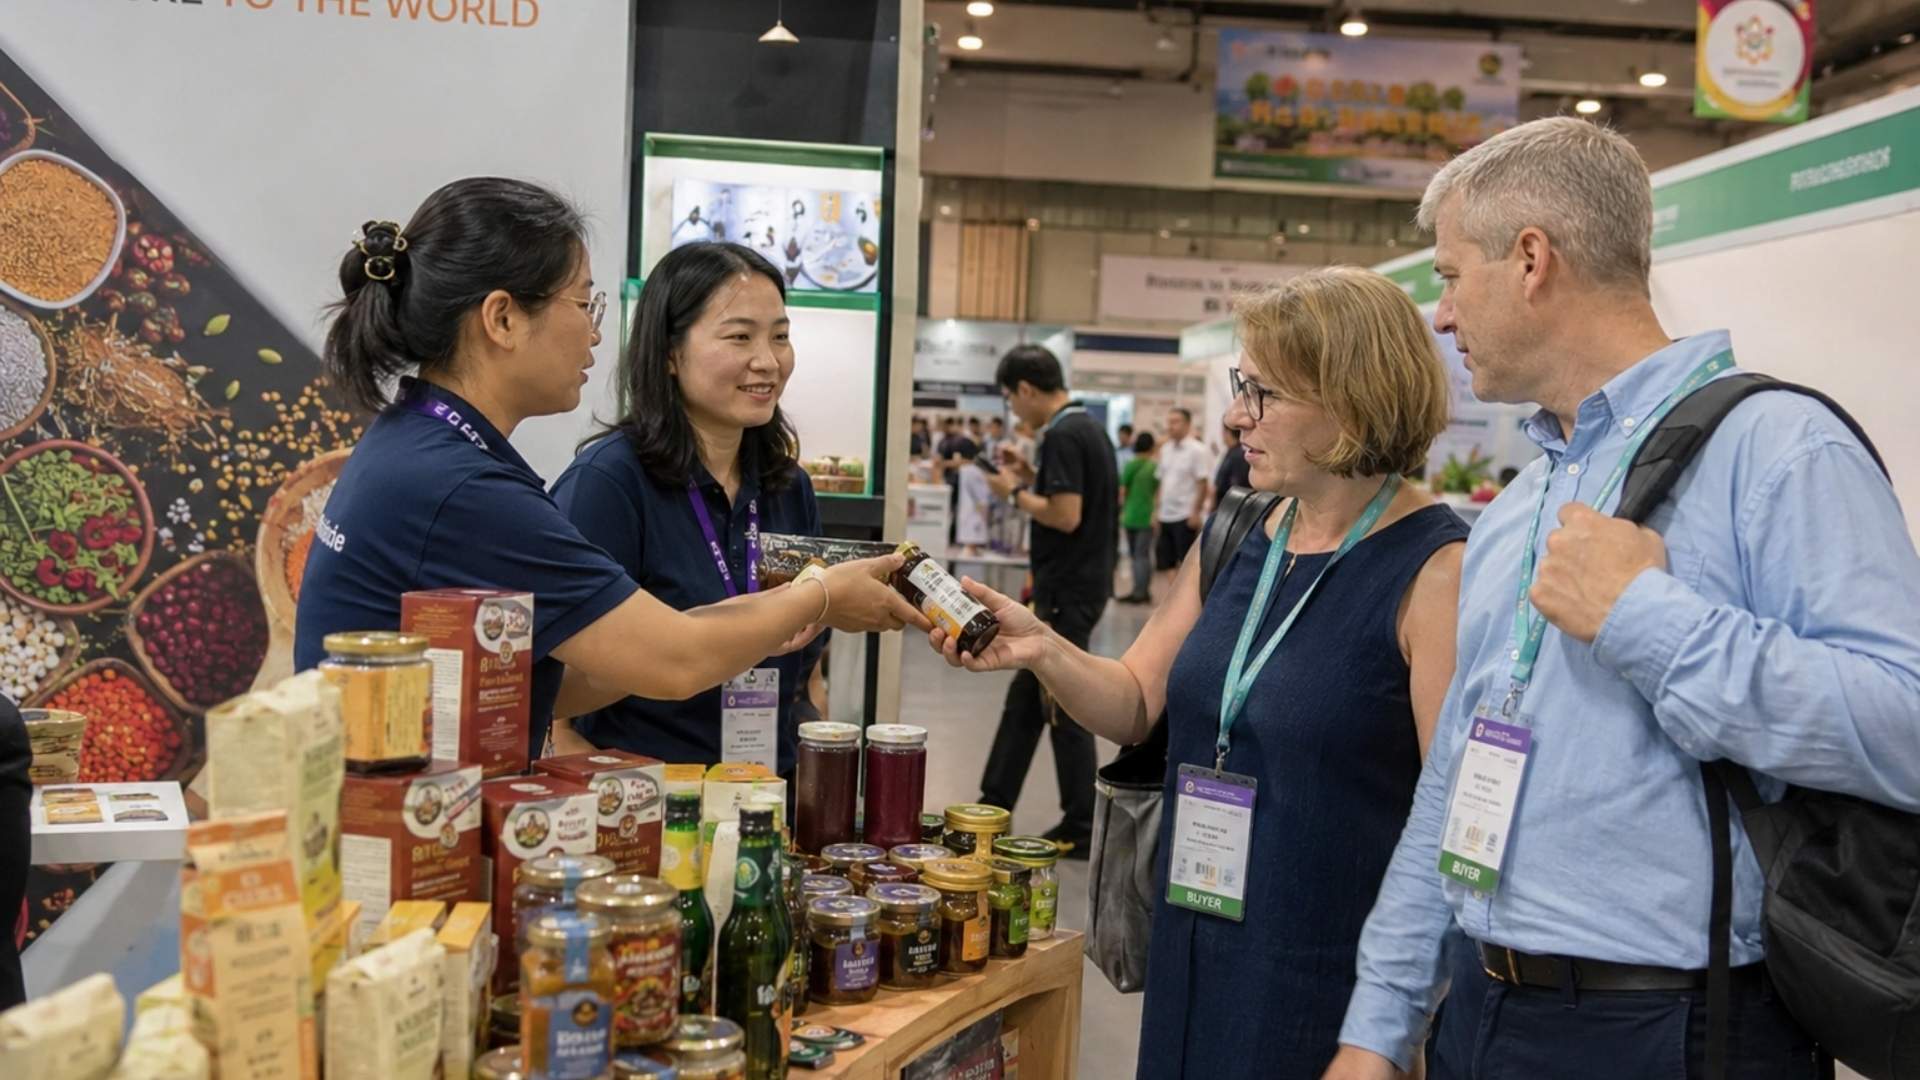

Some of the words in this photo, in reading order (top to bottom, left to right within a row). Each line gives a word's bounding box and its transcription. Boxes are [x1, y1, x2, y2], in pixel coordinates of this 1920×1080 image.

[388, 0, 540, 28] WORLD
[1451, 860, 1481, 882] BUYER
[1186, 891, 1222, 911] BUYER
